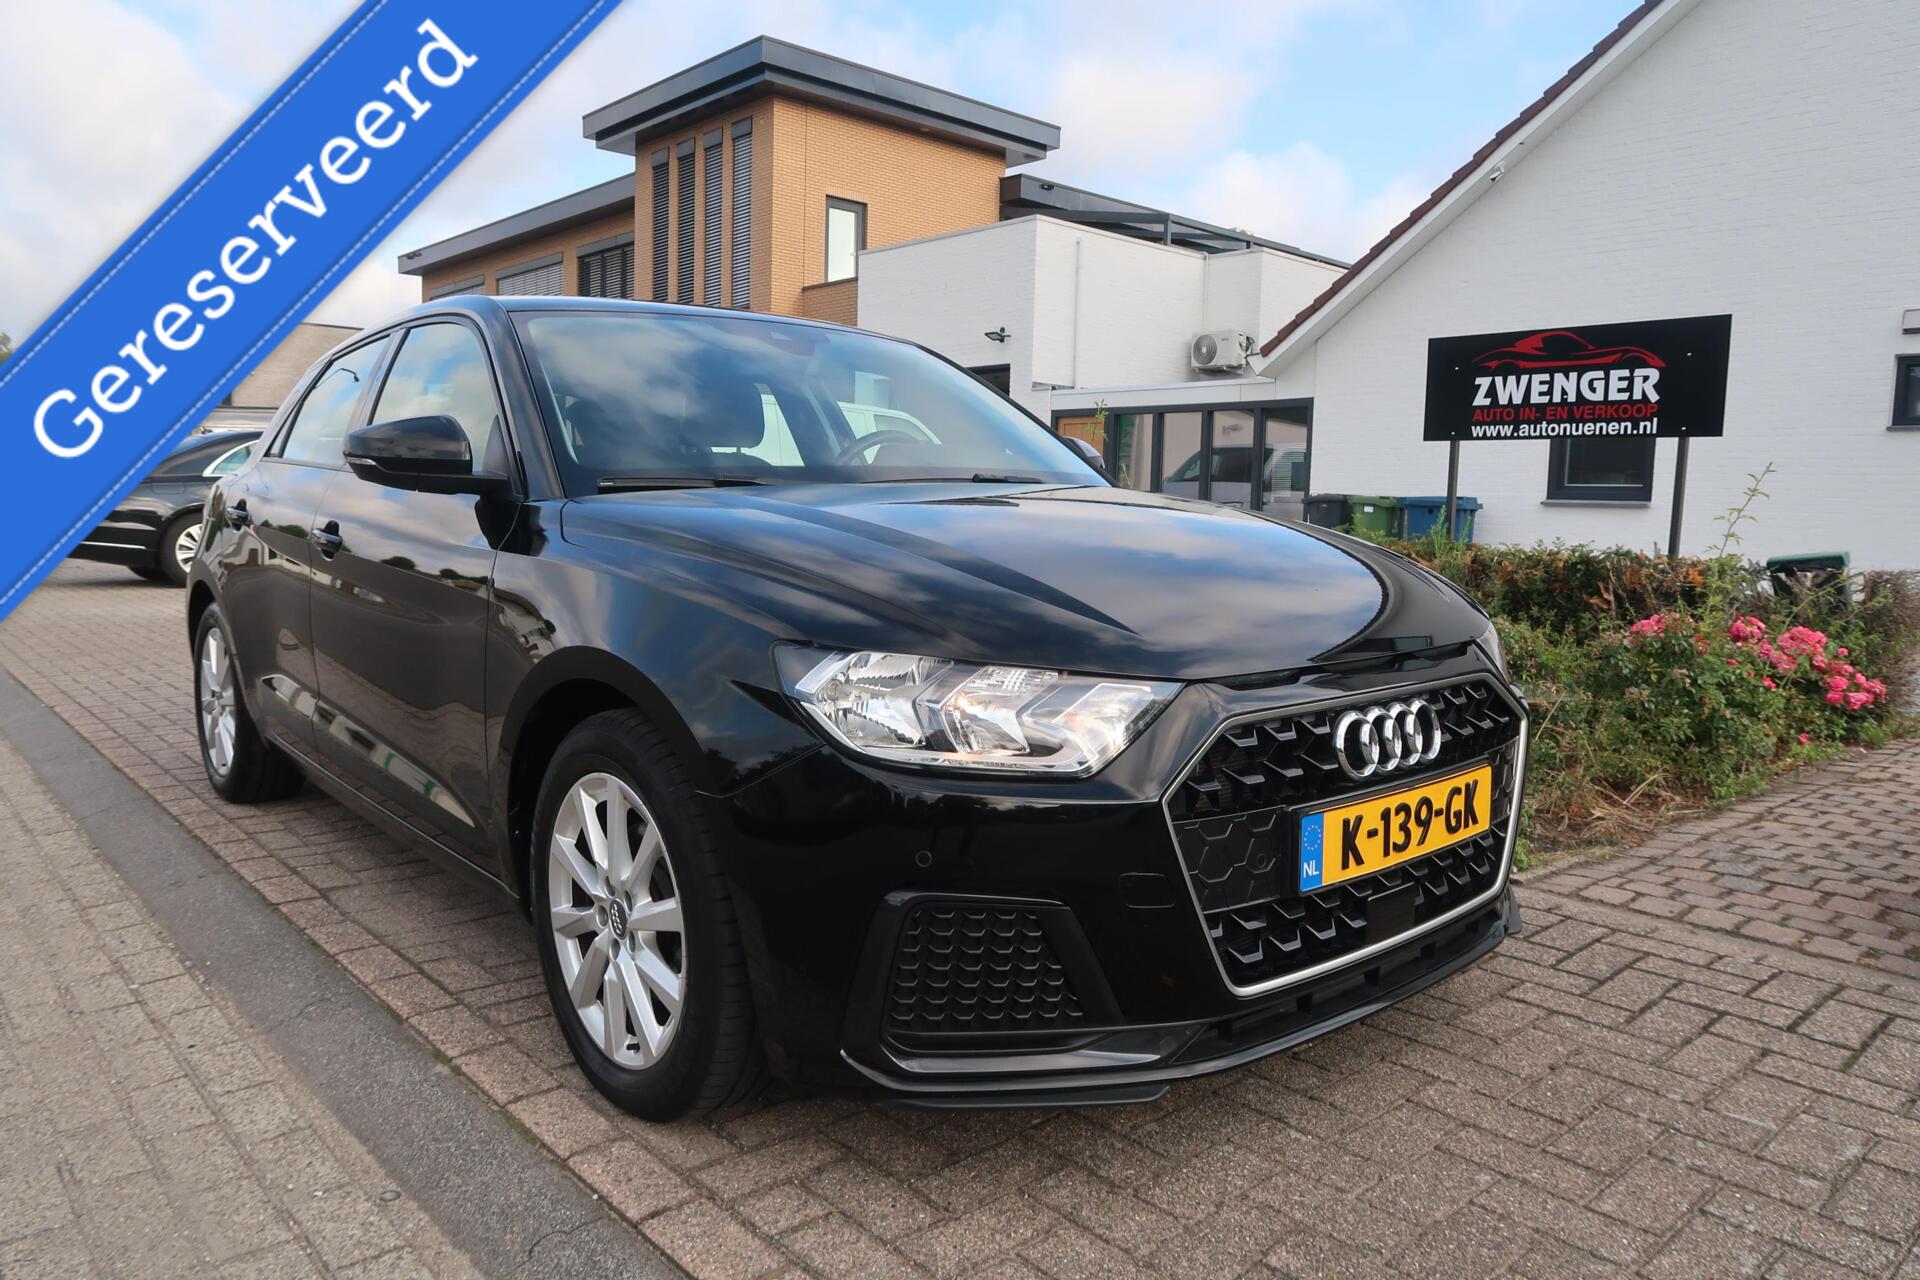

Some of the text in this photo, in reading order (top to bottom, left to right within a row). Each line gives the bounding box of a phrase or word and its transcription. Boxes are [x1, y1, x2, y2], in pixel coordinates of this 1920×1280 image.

[1472, 367, 1660, 406] ZWENGER
[1473, 403, 1658, 422] AUTO IN- EN VERKOOP
[1471, 417, 1658, 437] www.autonuenen.nl
[1341, 779, 1479, 870] K-139-GK
[1303, 860, 1320, 878] NL
